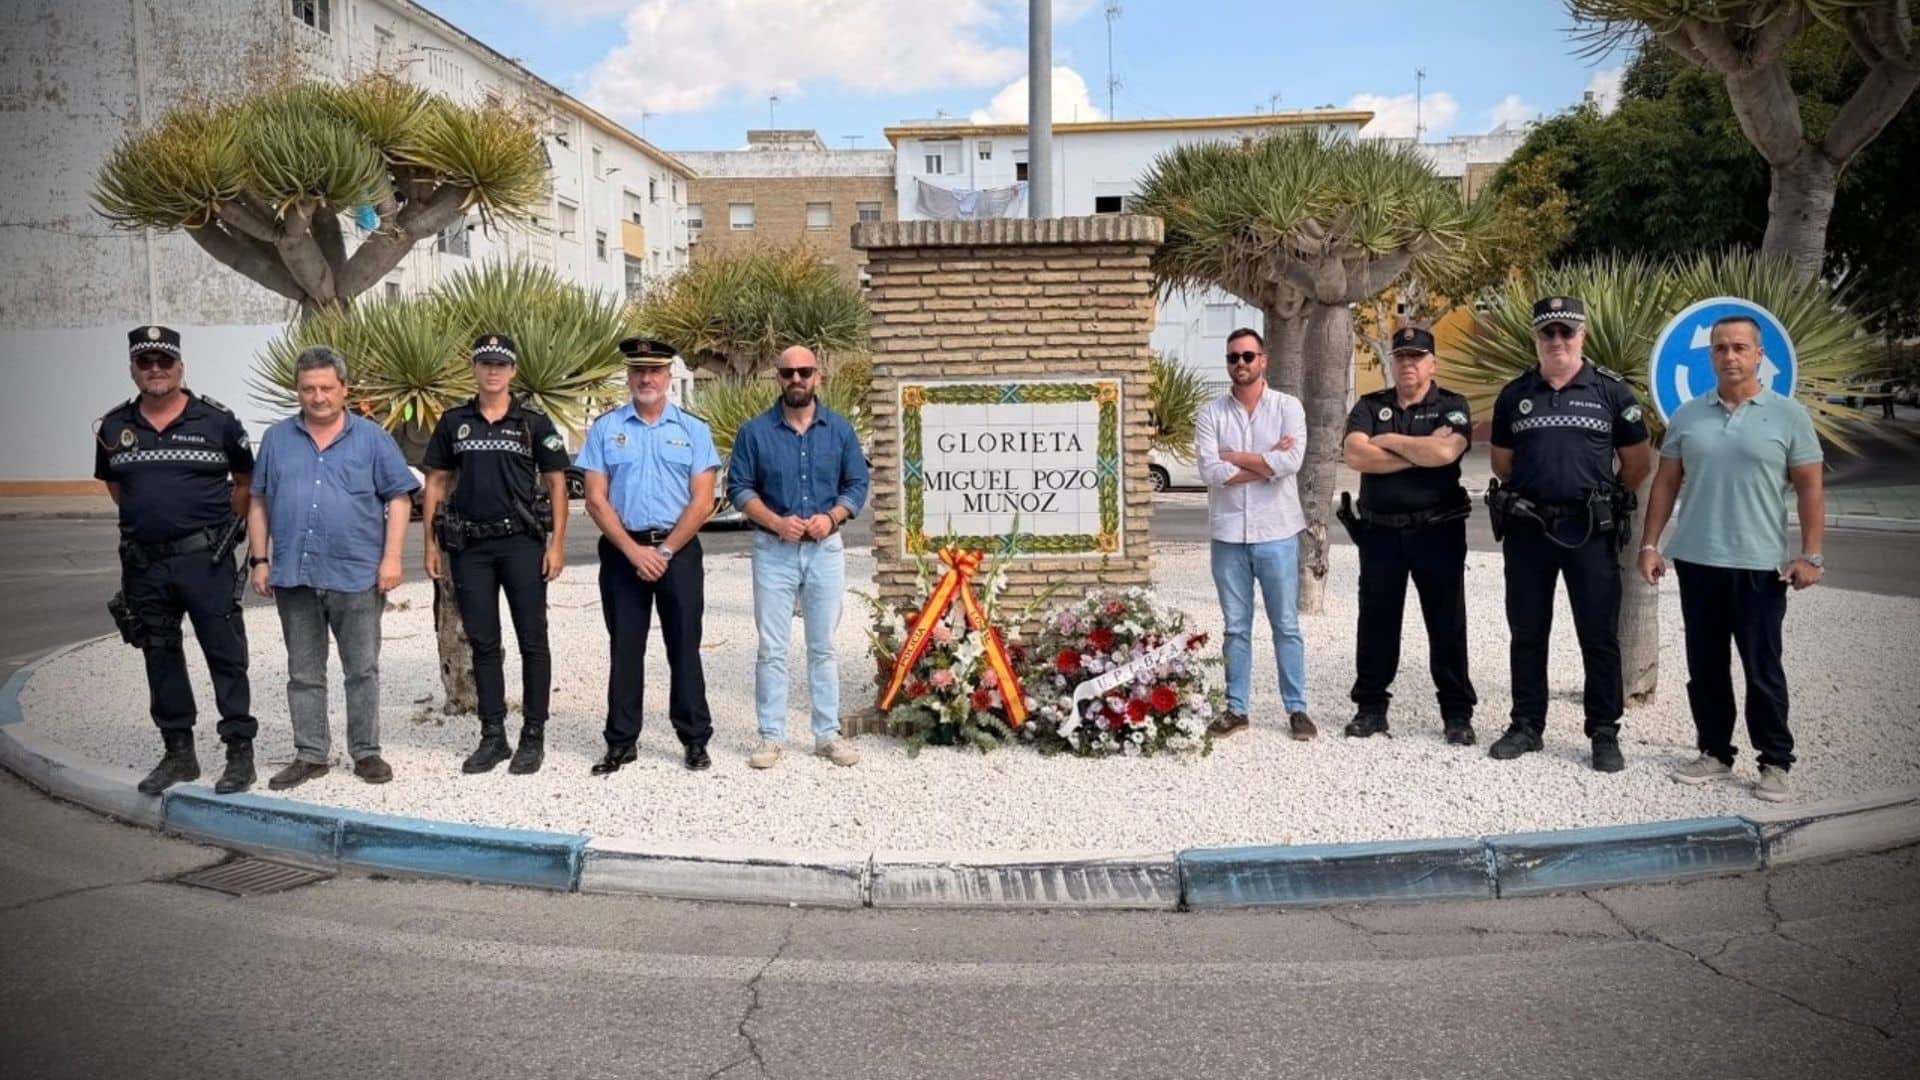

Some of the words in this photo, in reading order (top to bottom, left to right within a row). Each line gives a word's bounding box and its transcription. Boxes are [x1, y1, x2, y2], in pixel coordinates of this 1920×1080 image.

[937, 432, 1083, 453] GLORIETA
[924, 470, 1019, 491] MIGUEL
[1033, 470, 1099, 490] POZO
[963, 491, 1059, 513] MUÑOZ
